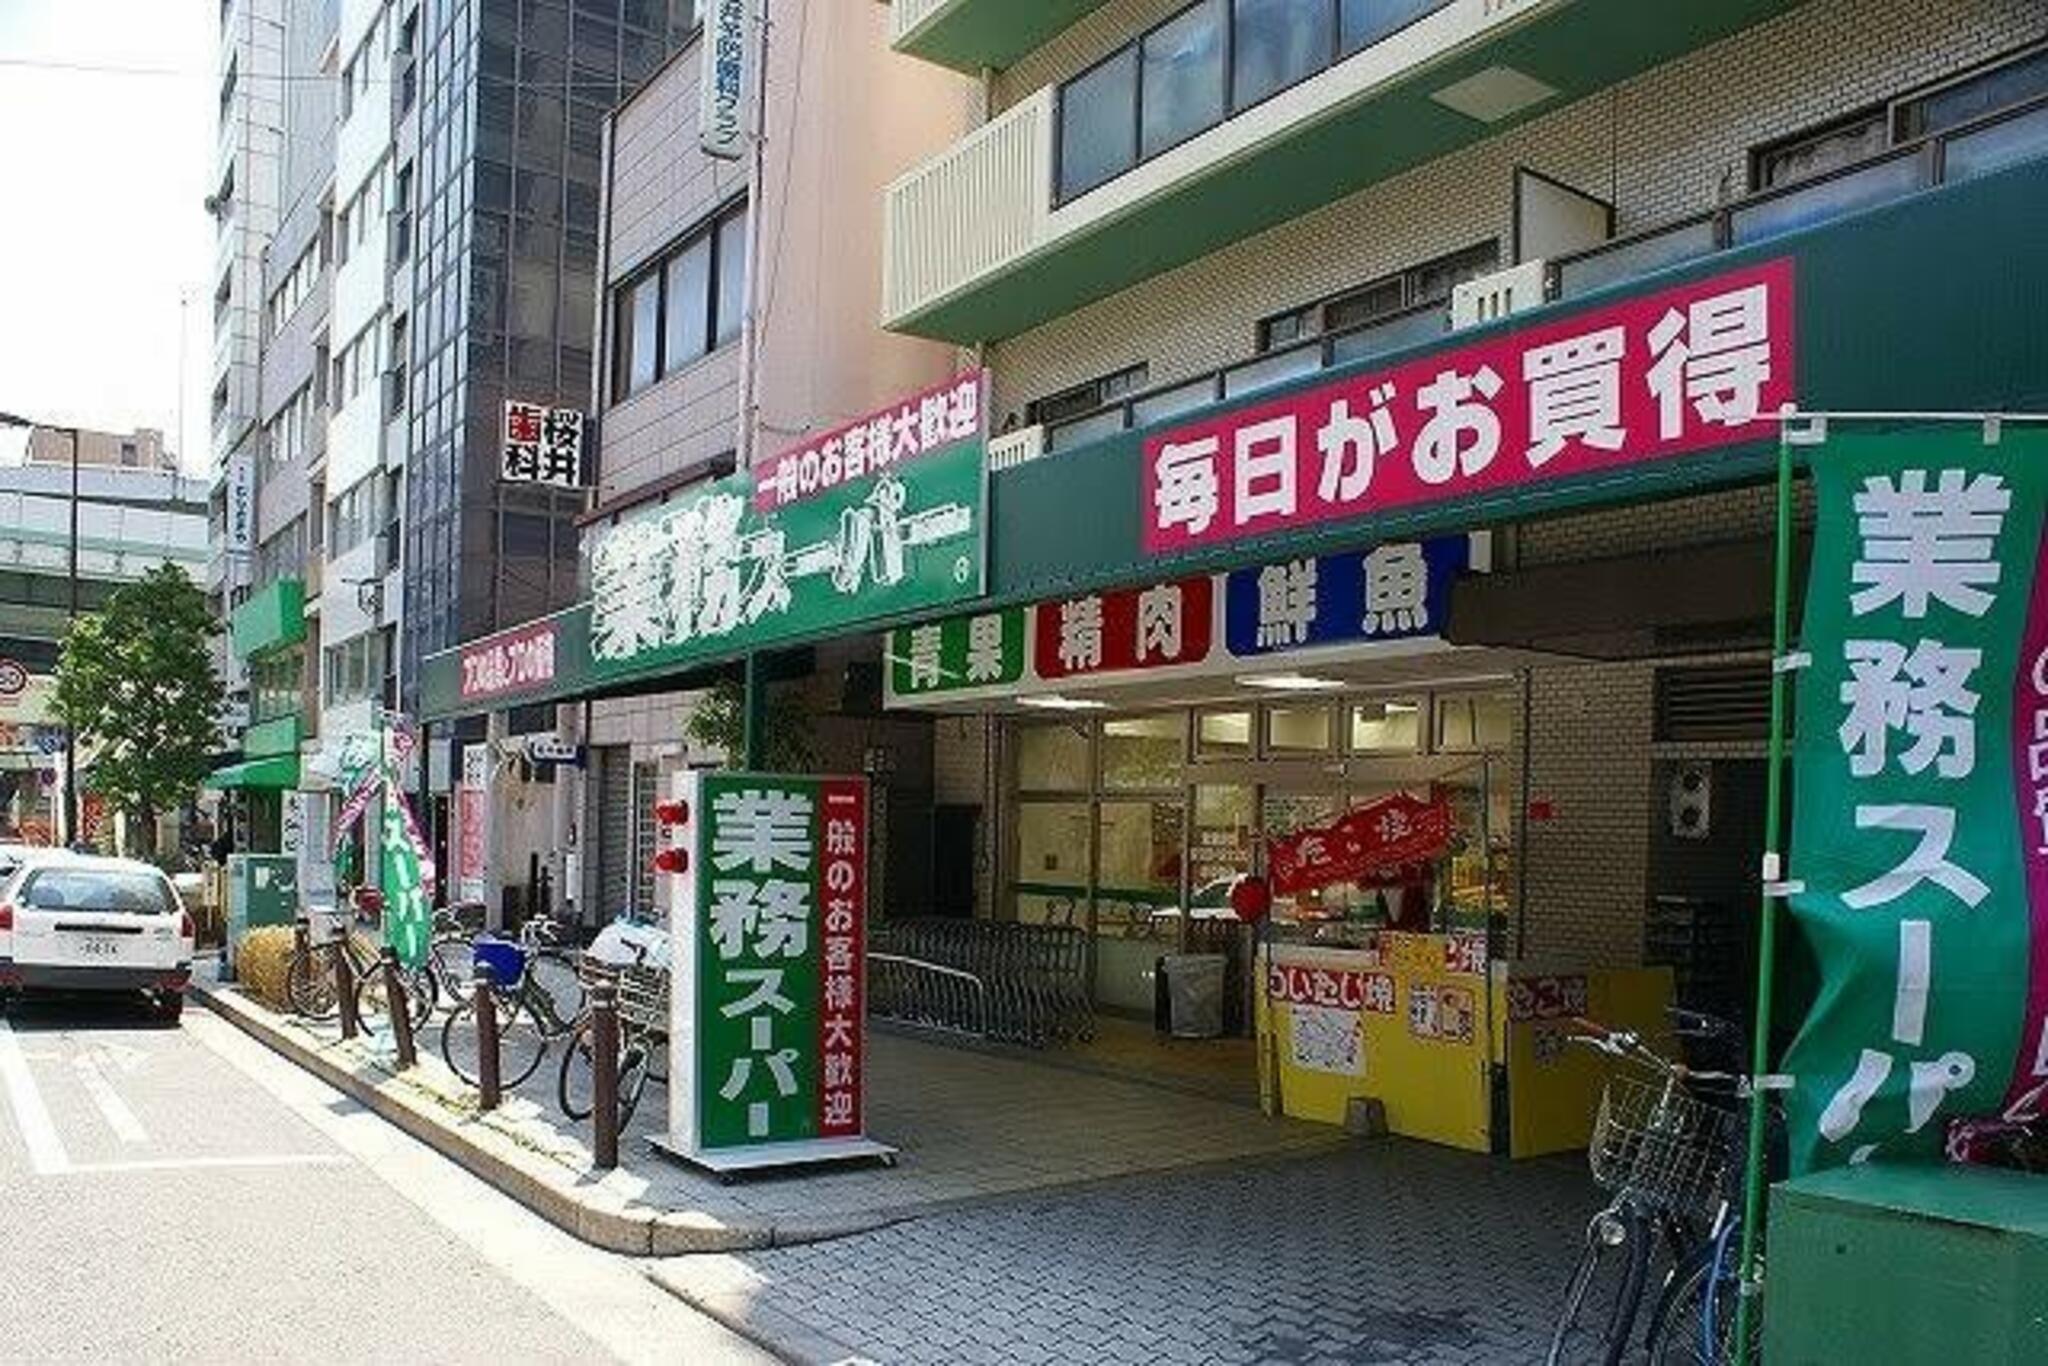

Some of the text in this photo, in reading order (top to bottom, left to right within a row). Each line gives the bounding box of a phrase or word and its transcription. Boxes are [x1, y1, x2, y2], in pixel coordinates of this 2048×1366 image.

[758, 380, 977, 504] 一般のお客様大歓迎
[1155, 284, 1770, 535] 毎日がお買得
[592, 474, 972, 662] 業務スーパー
[910, 613, 1003, 689] 青果
[1058, 585, 1182, 669] 精肉
[1256, 544, 1428, 646] 鮮魚
[1818, 469, 2012, 1166] 業務スーパ
[709, 789, 814, 1138] 業務スーパー
[823, 795, 856, 1127] 一般のお客様大歓迎
